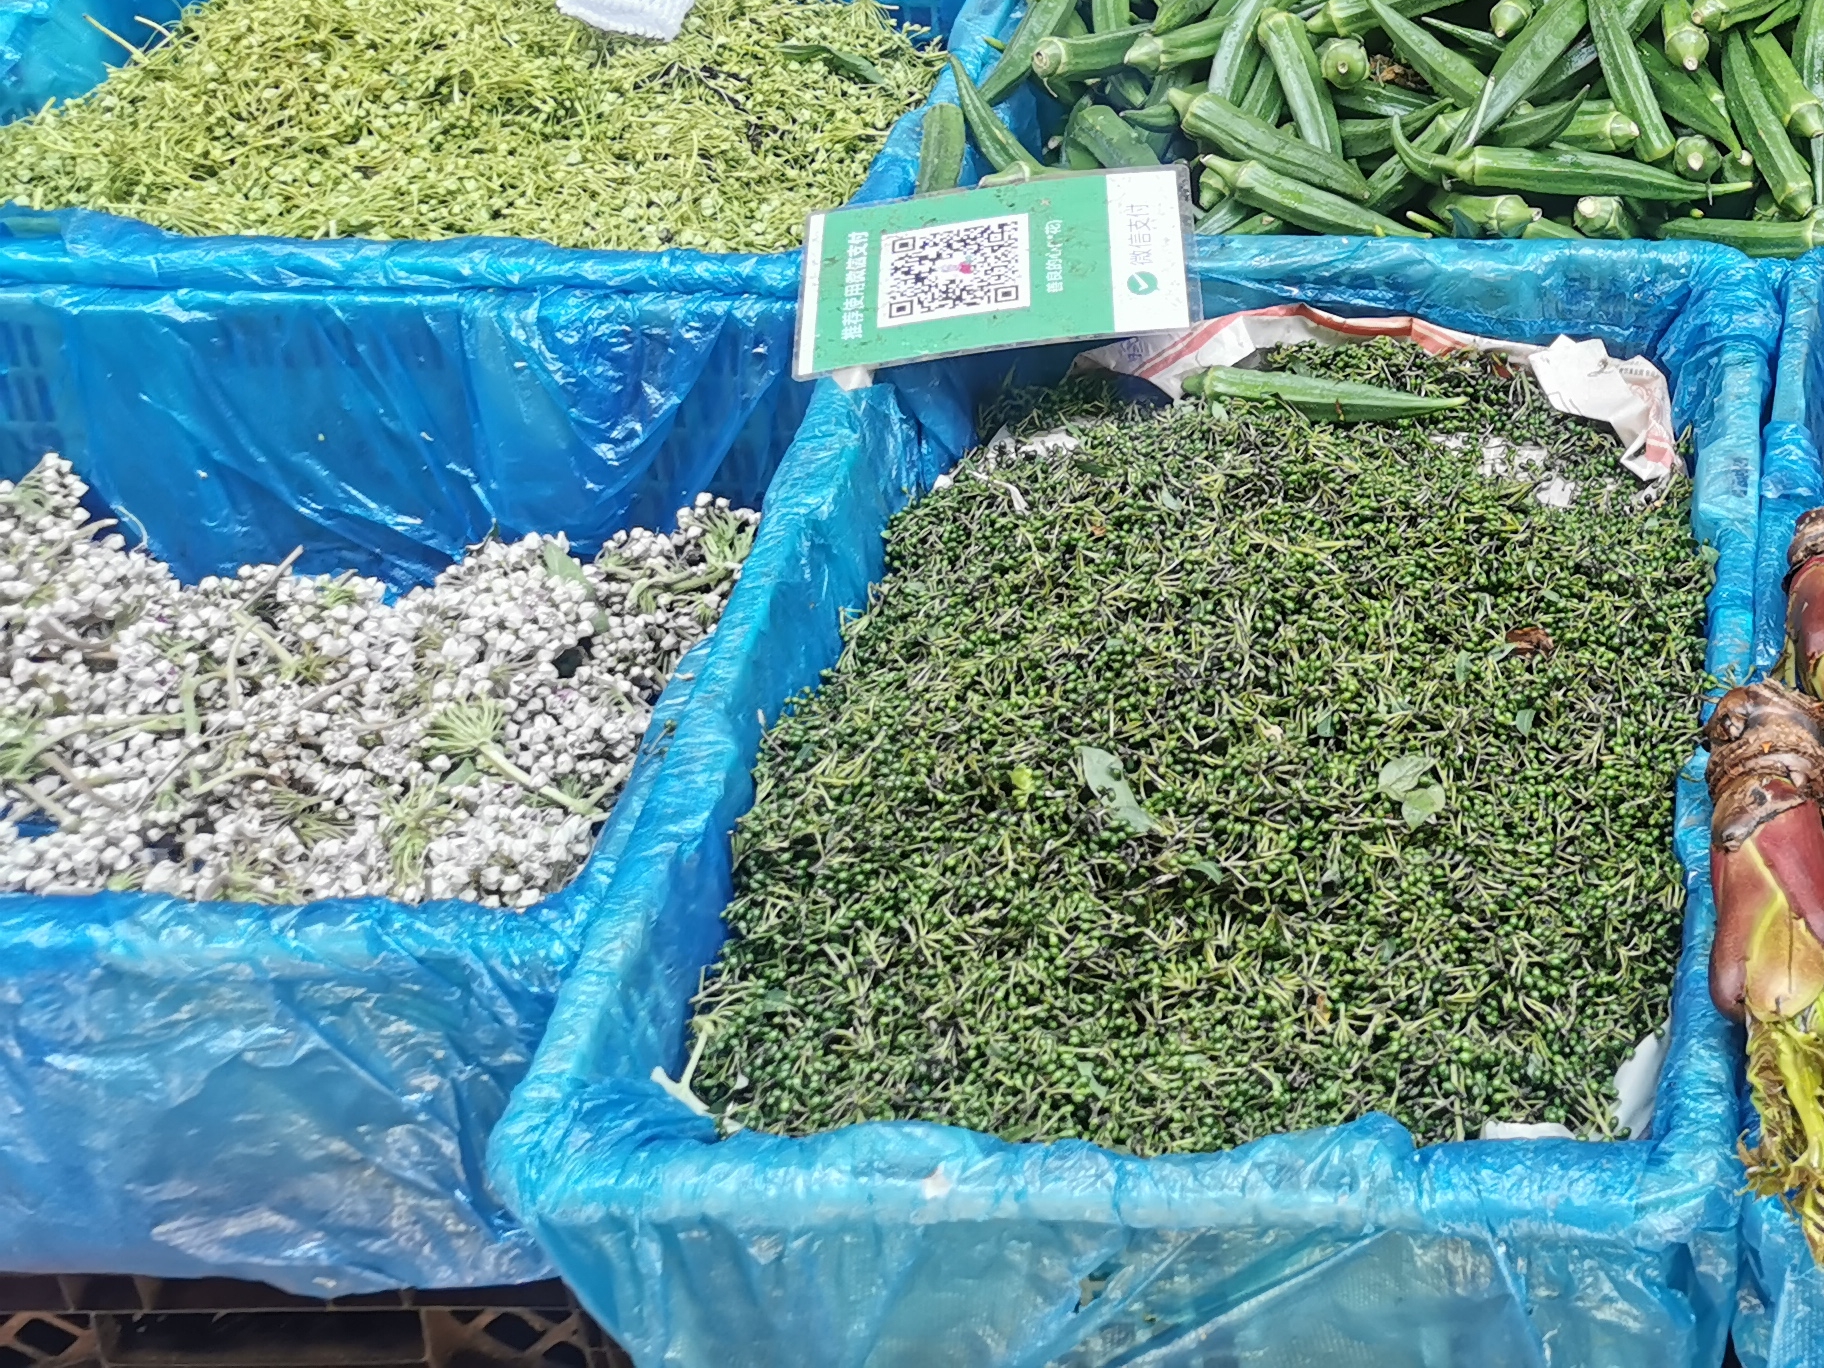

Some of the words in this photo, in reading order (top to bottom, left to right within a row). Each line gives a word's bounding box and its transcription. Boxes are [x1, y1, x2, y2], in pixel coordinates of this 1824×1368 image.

[1128, 203, 1152, 266] 微信支付
[841, 231, 869, 341] 推荐使用微信支付
